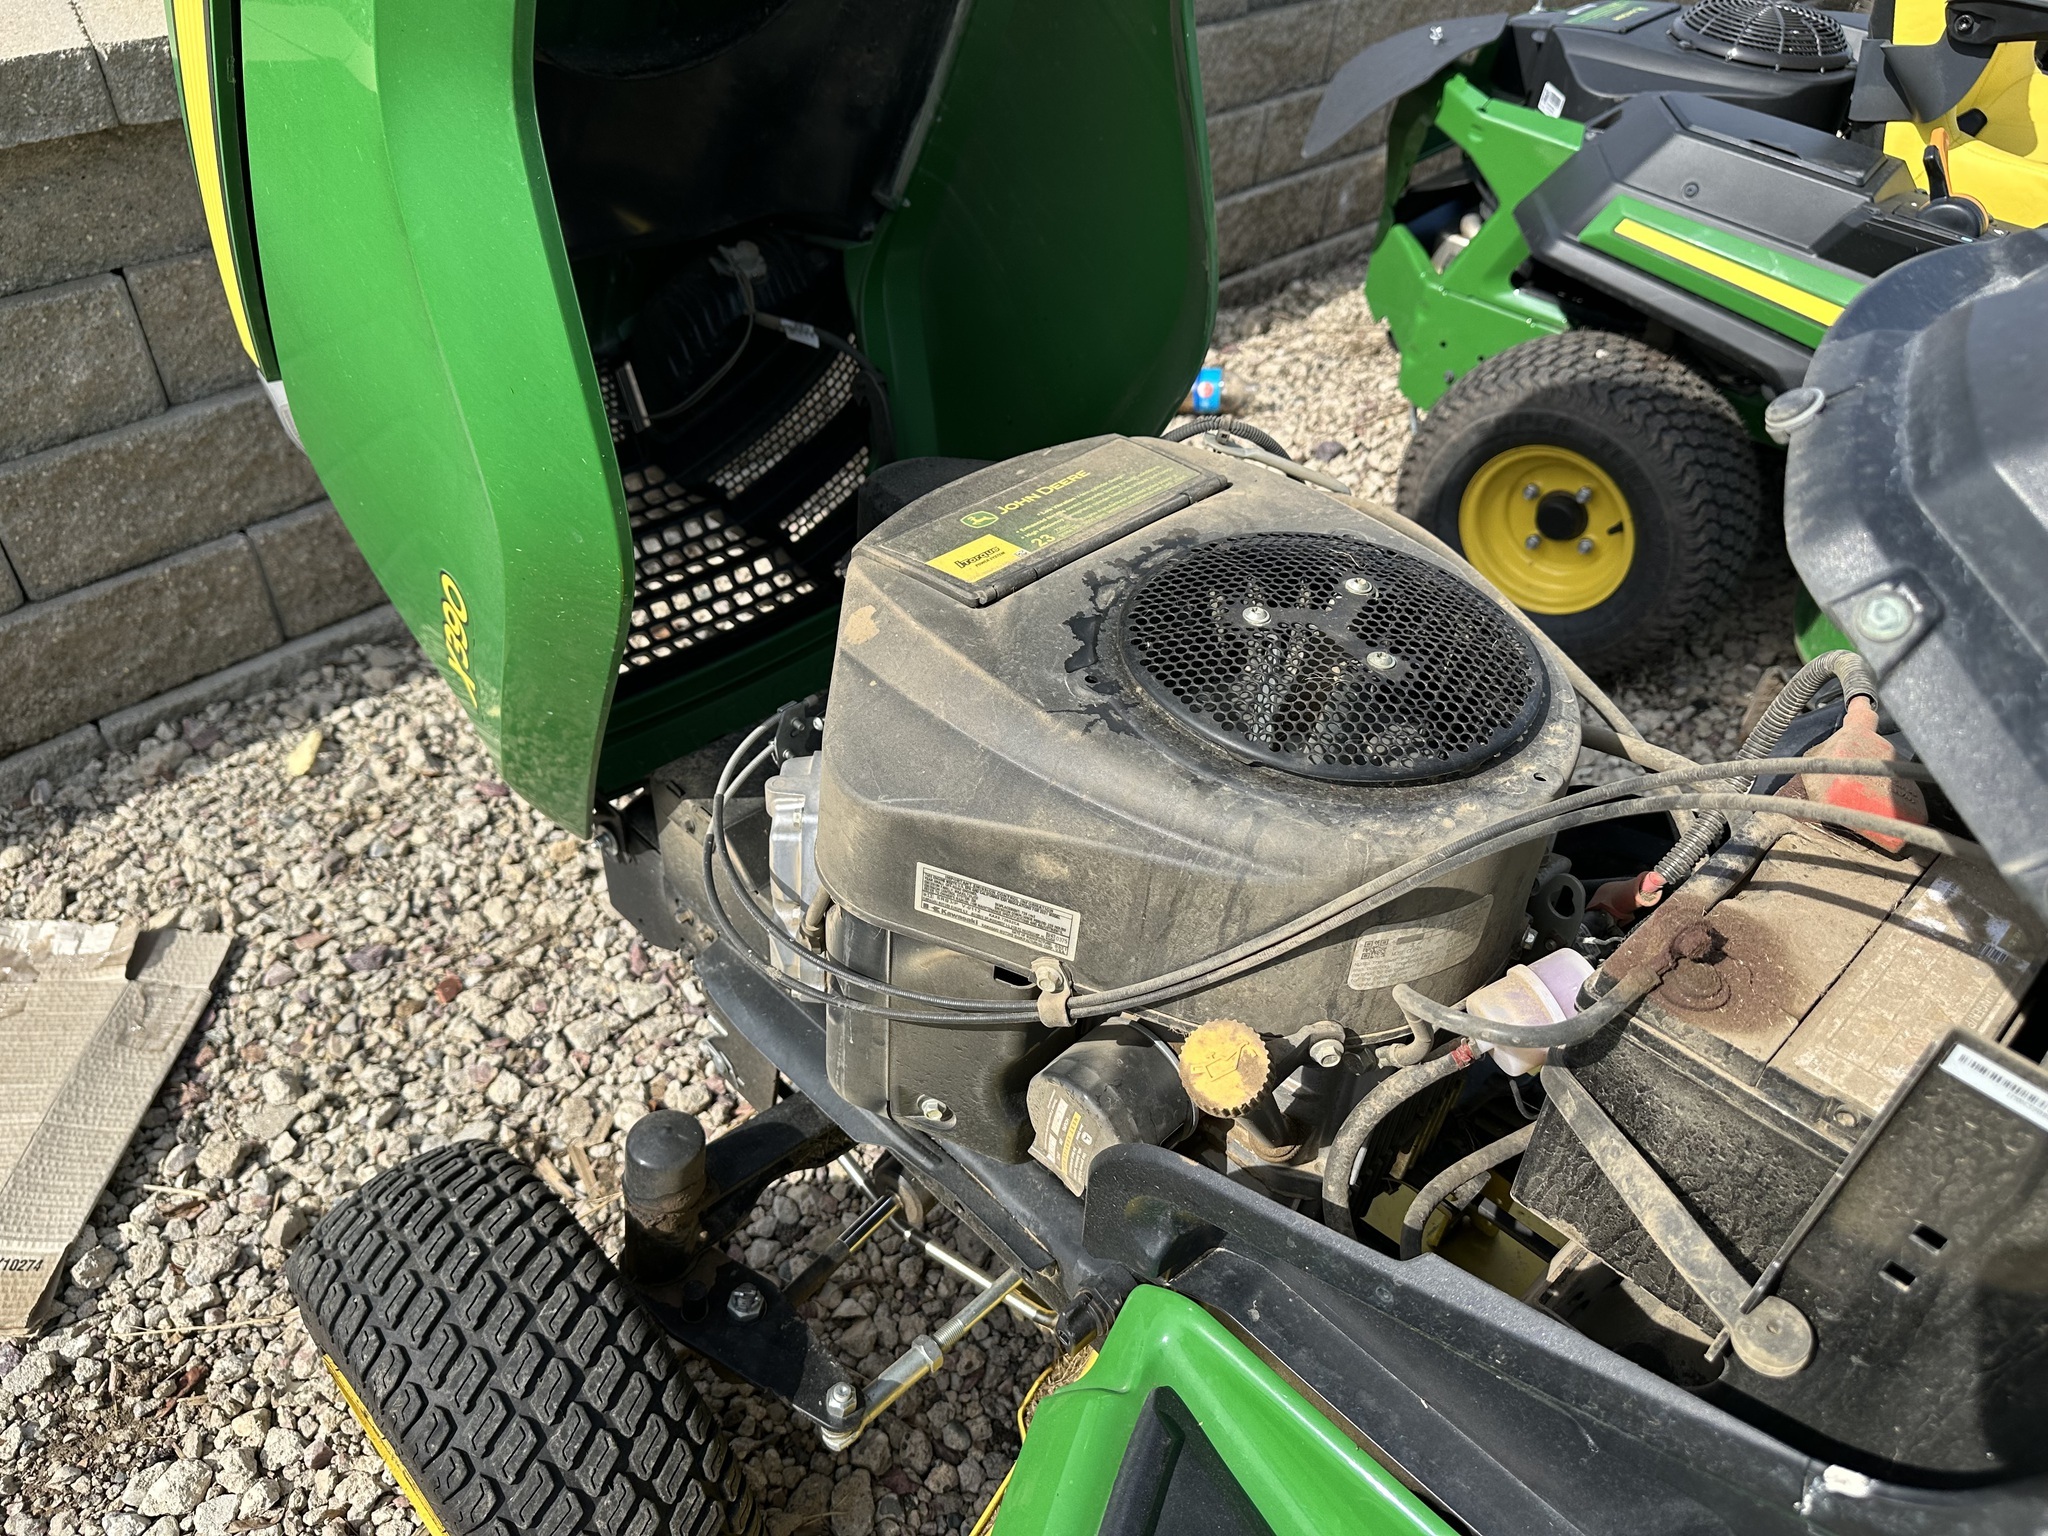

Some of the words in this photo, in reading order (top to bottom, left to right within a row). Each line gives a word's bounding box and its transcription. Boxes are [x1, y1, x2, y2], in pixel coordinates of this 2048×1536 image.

[997, 492, 1041, 515] JOHN
[1035, 469, 1091, 495] DEERE
[1031, 534, 1055, 547] 23
[439, 569, 478, 709] X390
[941, 908, 978, 925] Kawasaki
[0, 1257, 44, 1271] 10274
